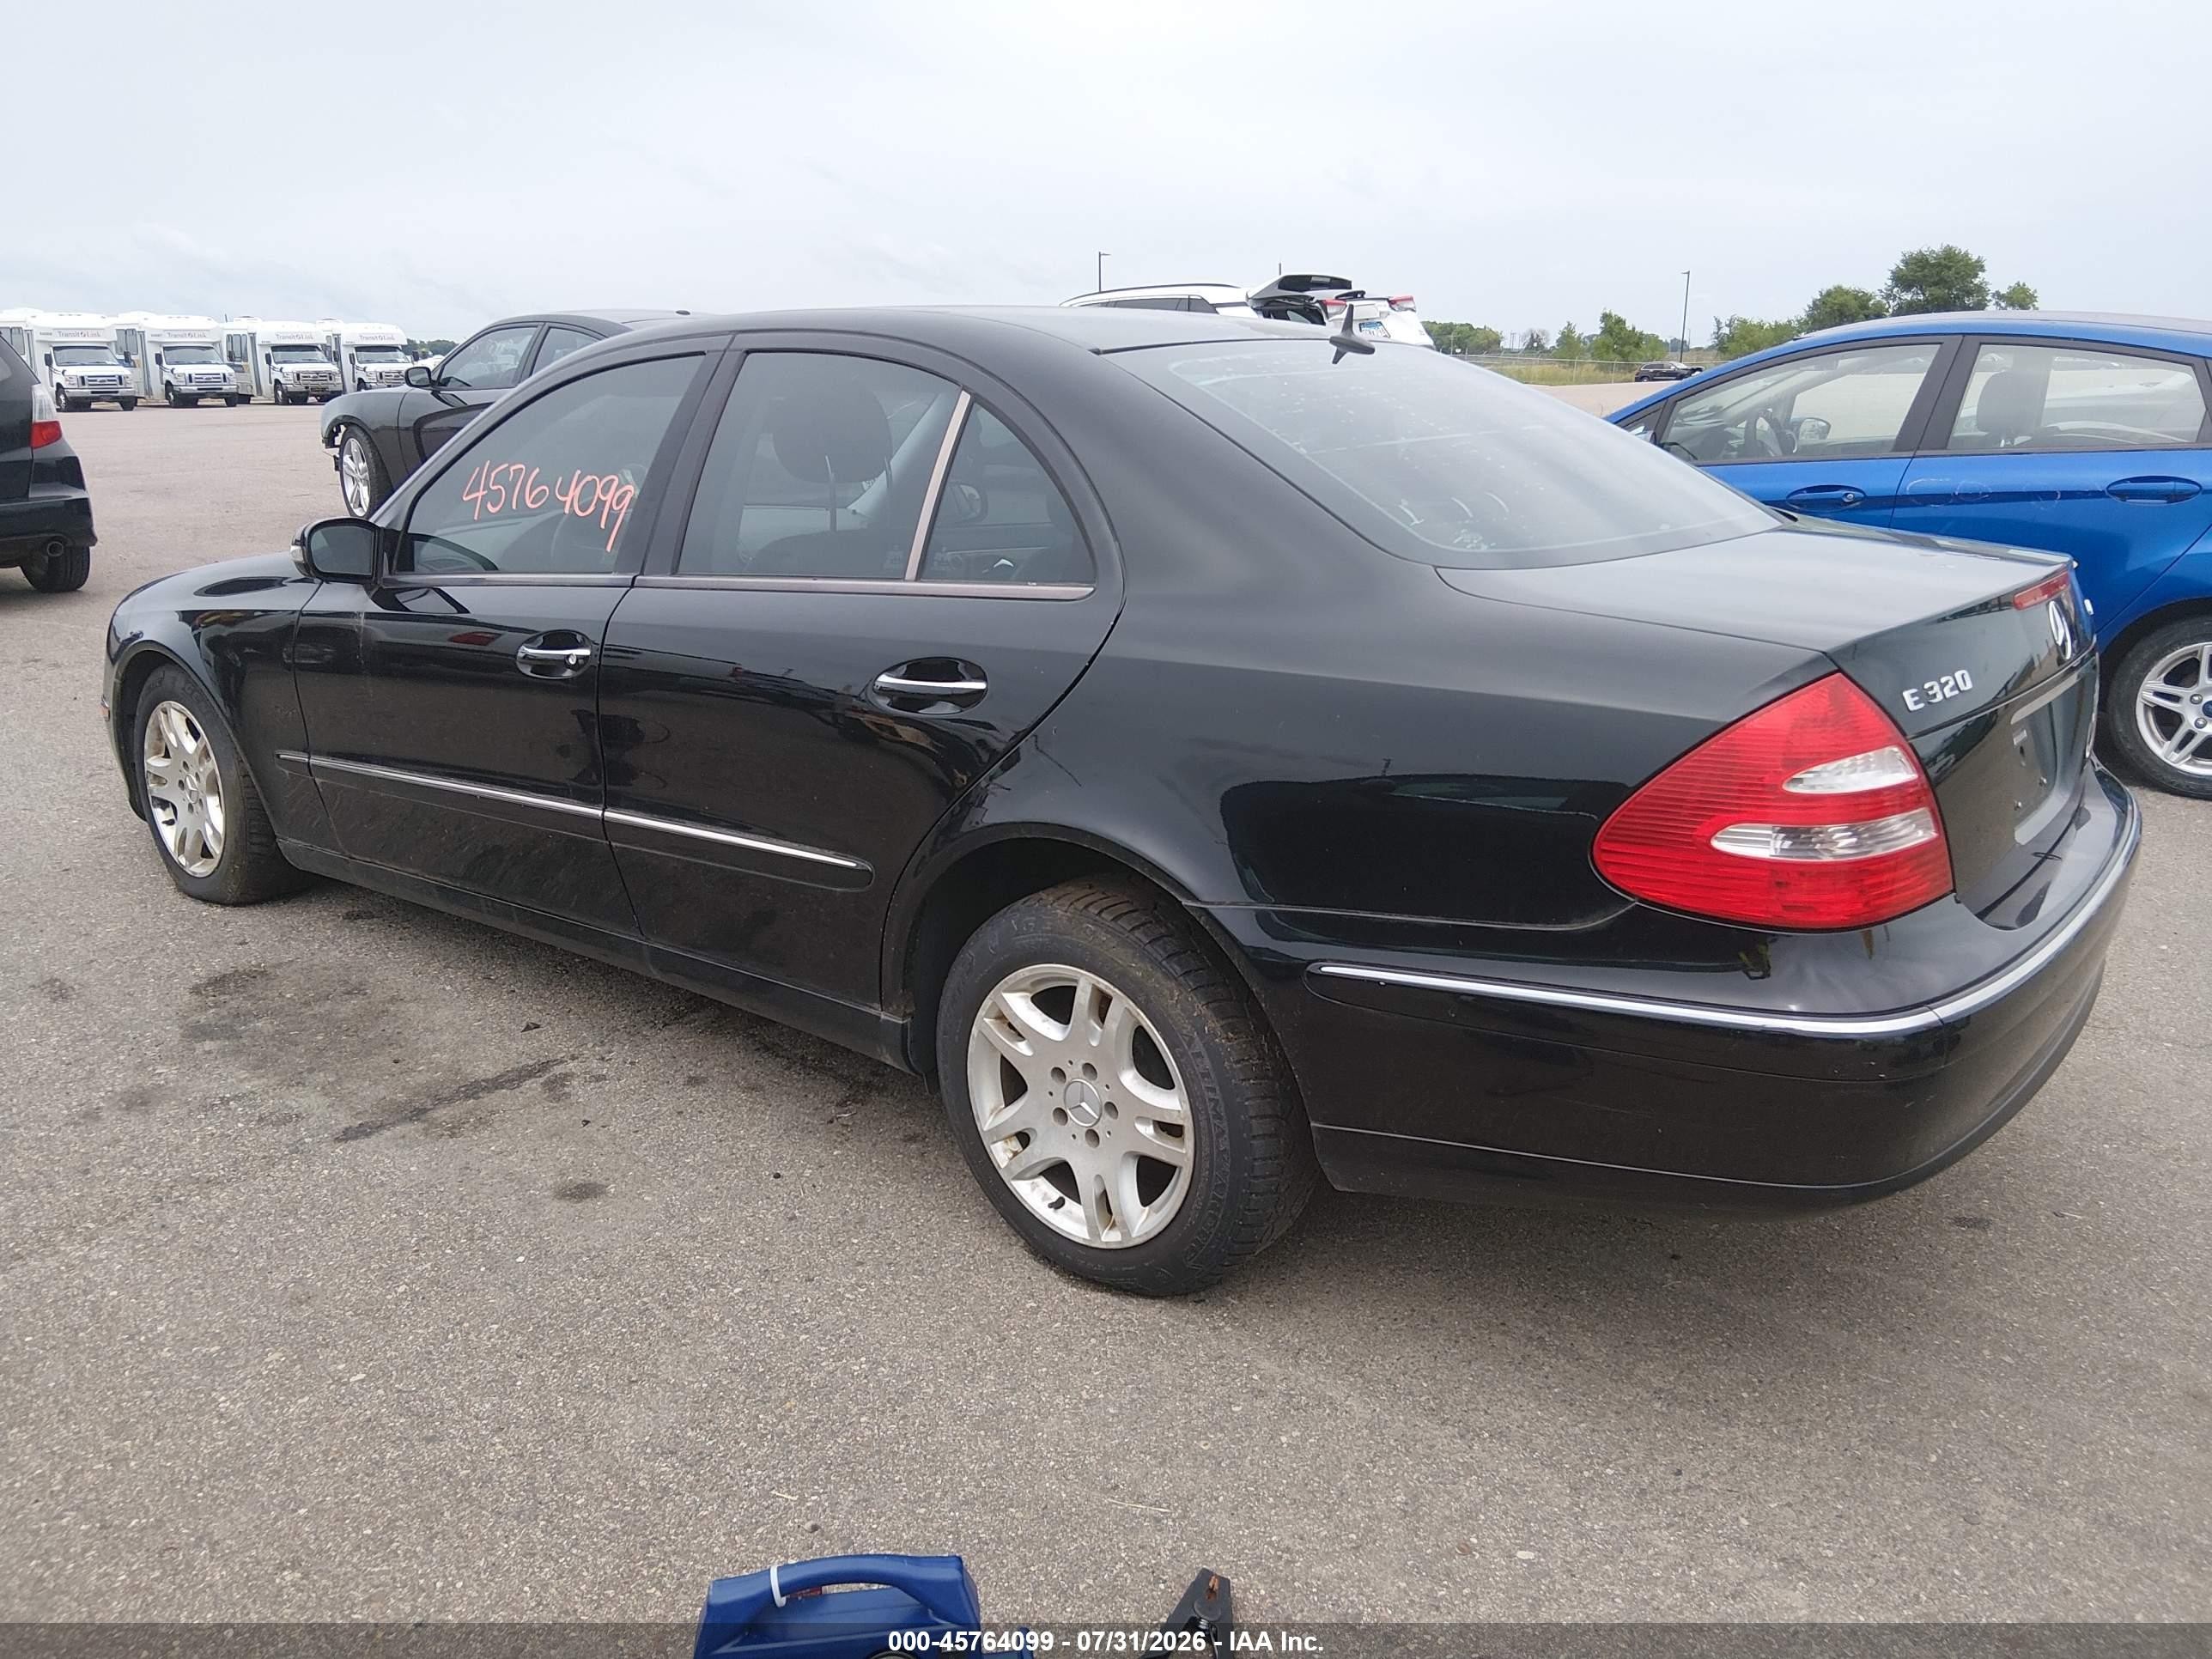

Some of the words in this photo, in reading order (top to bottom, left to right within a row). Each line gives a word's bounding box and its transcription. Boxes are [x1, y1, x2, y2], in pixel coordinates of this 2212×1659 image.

[462, 459, 635, 552] 45764099
[1902, 688, 1925, 712] E
[1923, 669, 1972, 703] 320
